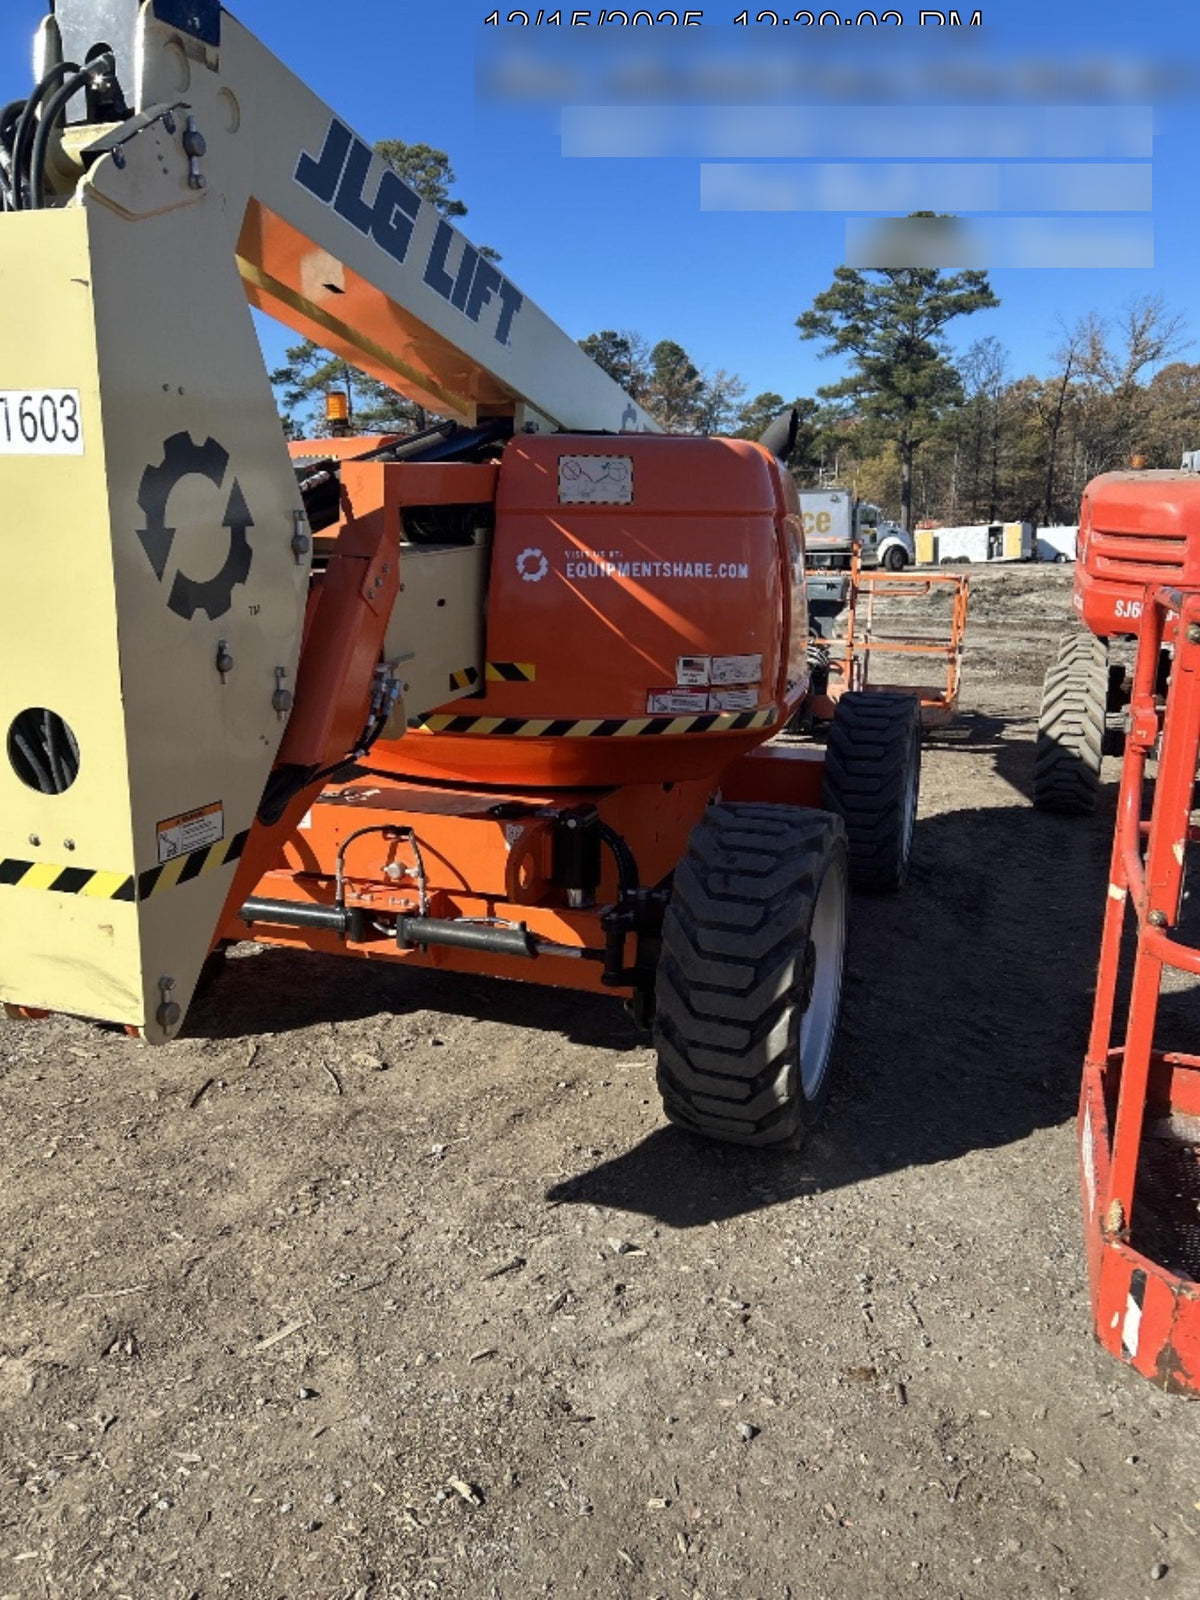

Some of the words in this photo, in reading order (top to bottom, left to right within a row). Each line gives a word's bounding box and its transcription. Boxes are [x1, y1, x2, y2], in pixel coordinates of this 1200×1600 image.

[293, 117, 422, 266] JLG
[421, 217, 523, 346] LIFT
[566, 562, 748, 579] EQUIPMENTSHARE.COM
[1114, 599, 1145, 618] SJ6
